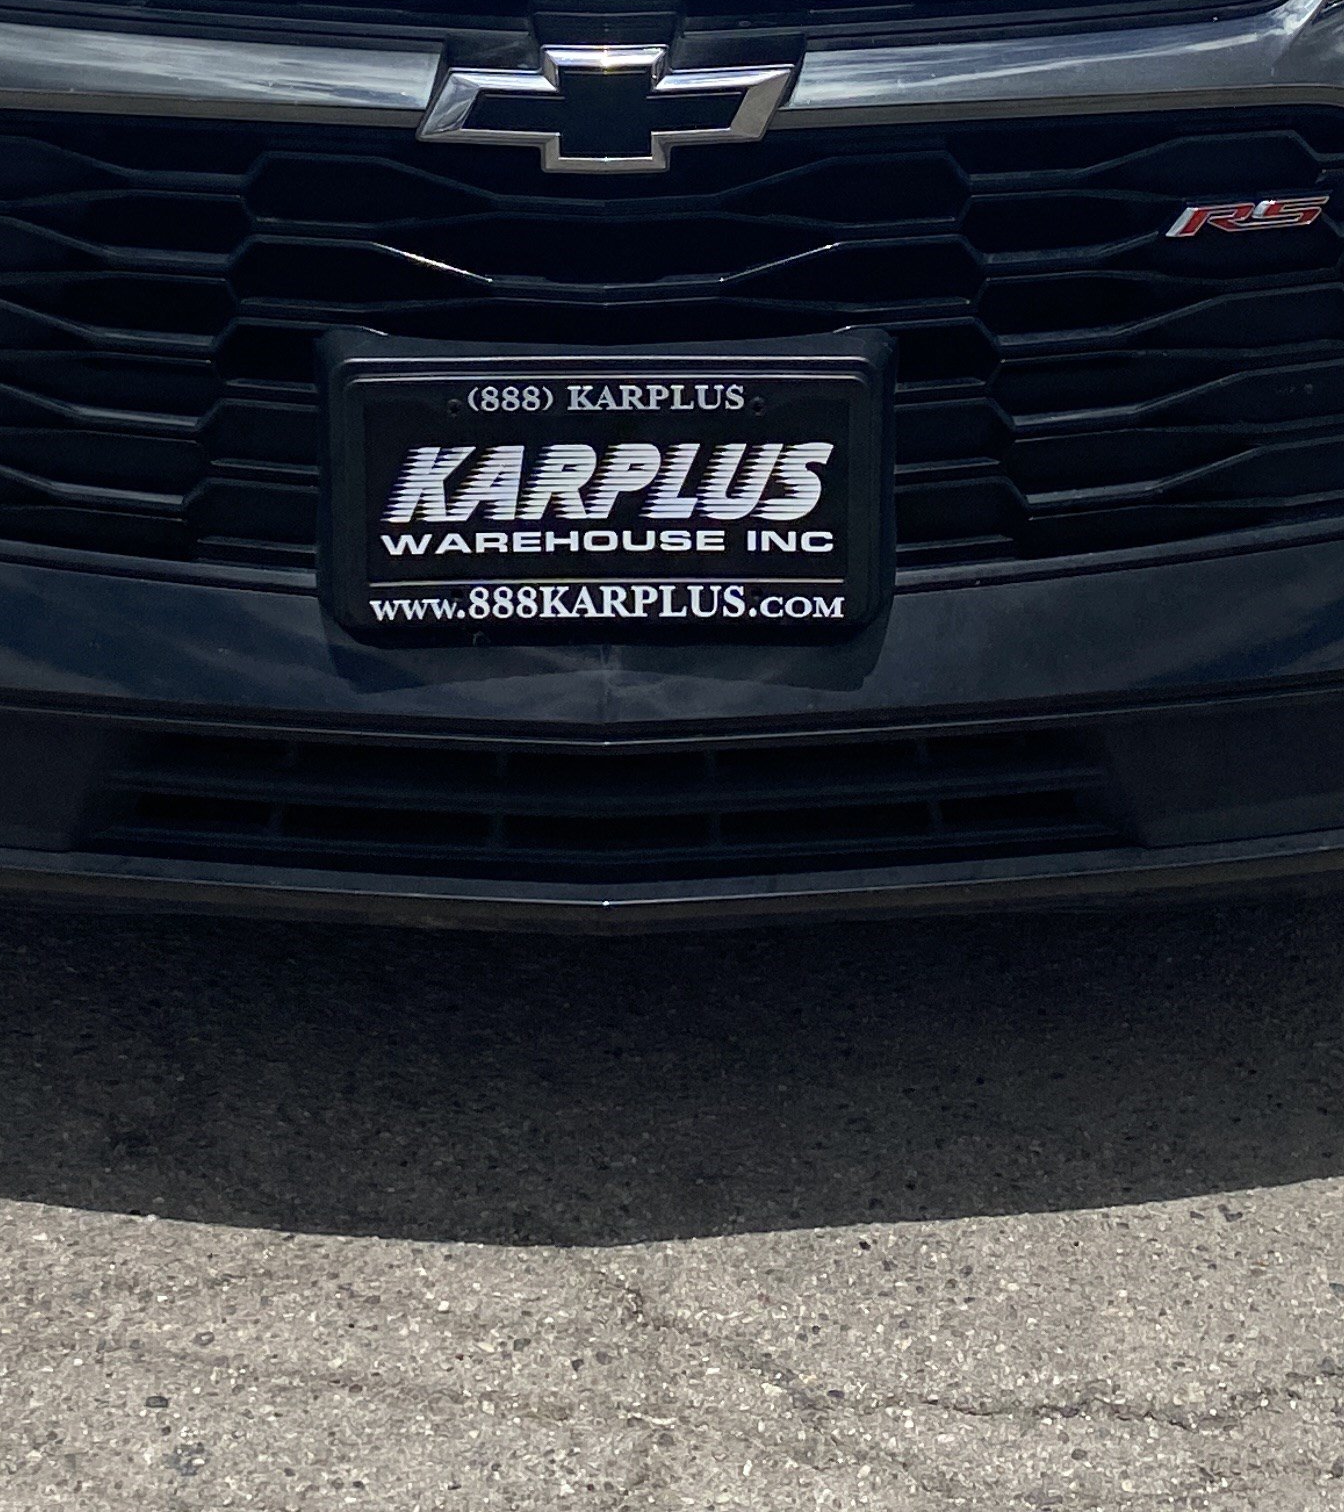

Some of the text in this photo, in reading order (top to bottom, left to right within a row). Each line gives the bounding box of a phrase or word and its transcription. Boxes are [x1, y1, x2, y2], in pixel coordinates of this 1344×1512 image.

[1165, 195, 1330, 238] RS
[467, 384, 745, 412] (888) KARPLUS
[379, 441, 835, 523] KARPLUS
[380, 530, 835, 556] WAREHOUSE INC
